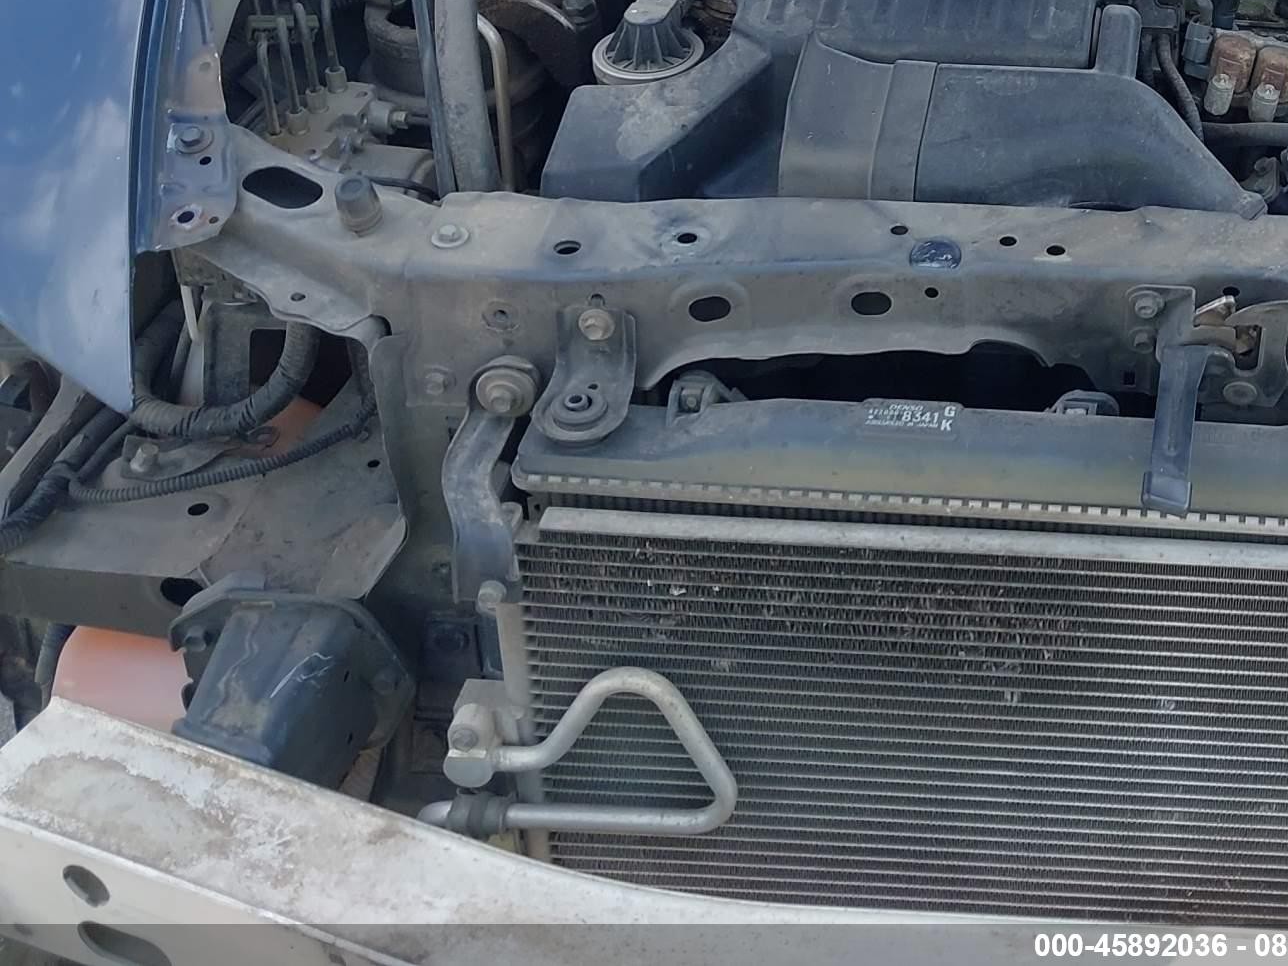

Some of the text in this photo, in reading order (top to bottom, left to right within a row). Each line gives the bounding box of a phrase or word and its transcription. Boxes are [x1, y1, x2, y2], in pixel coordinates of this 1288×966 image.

[944, 406, 957, 417] G
[901, 410, 940, 423] 8341
[940, 419, 953, 431] K
